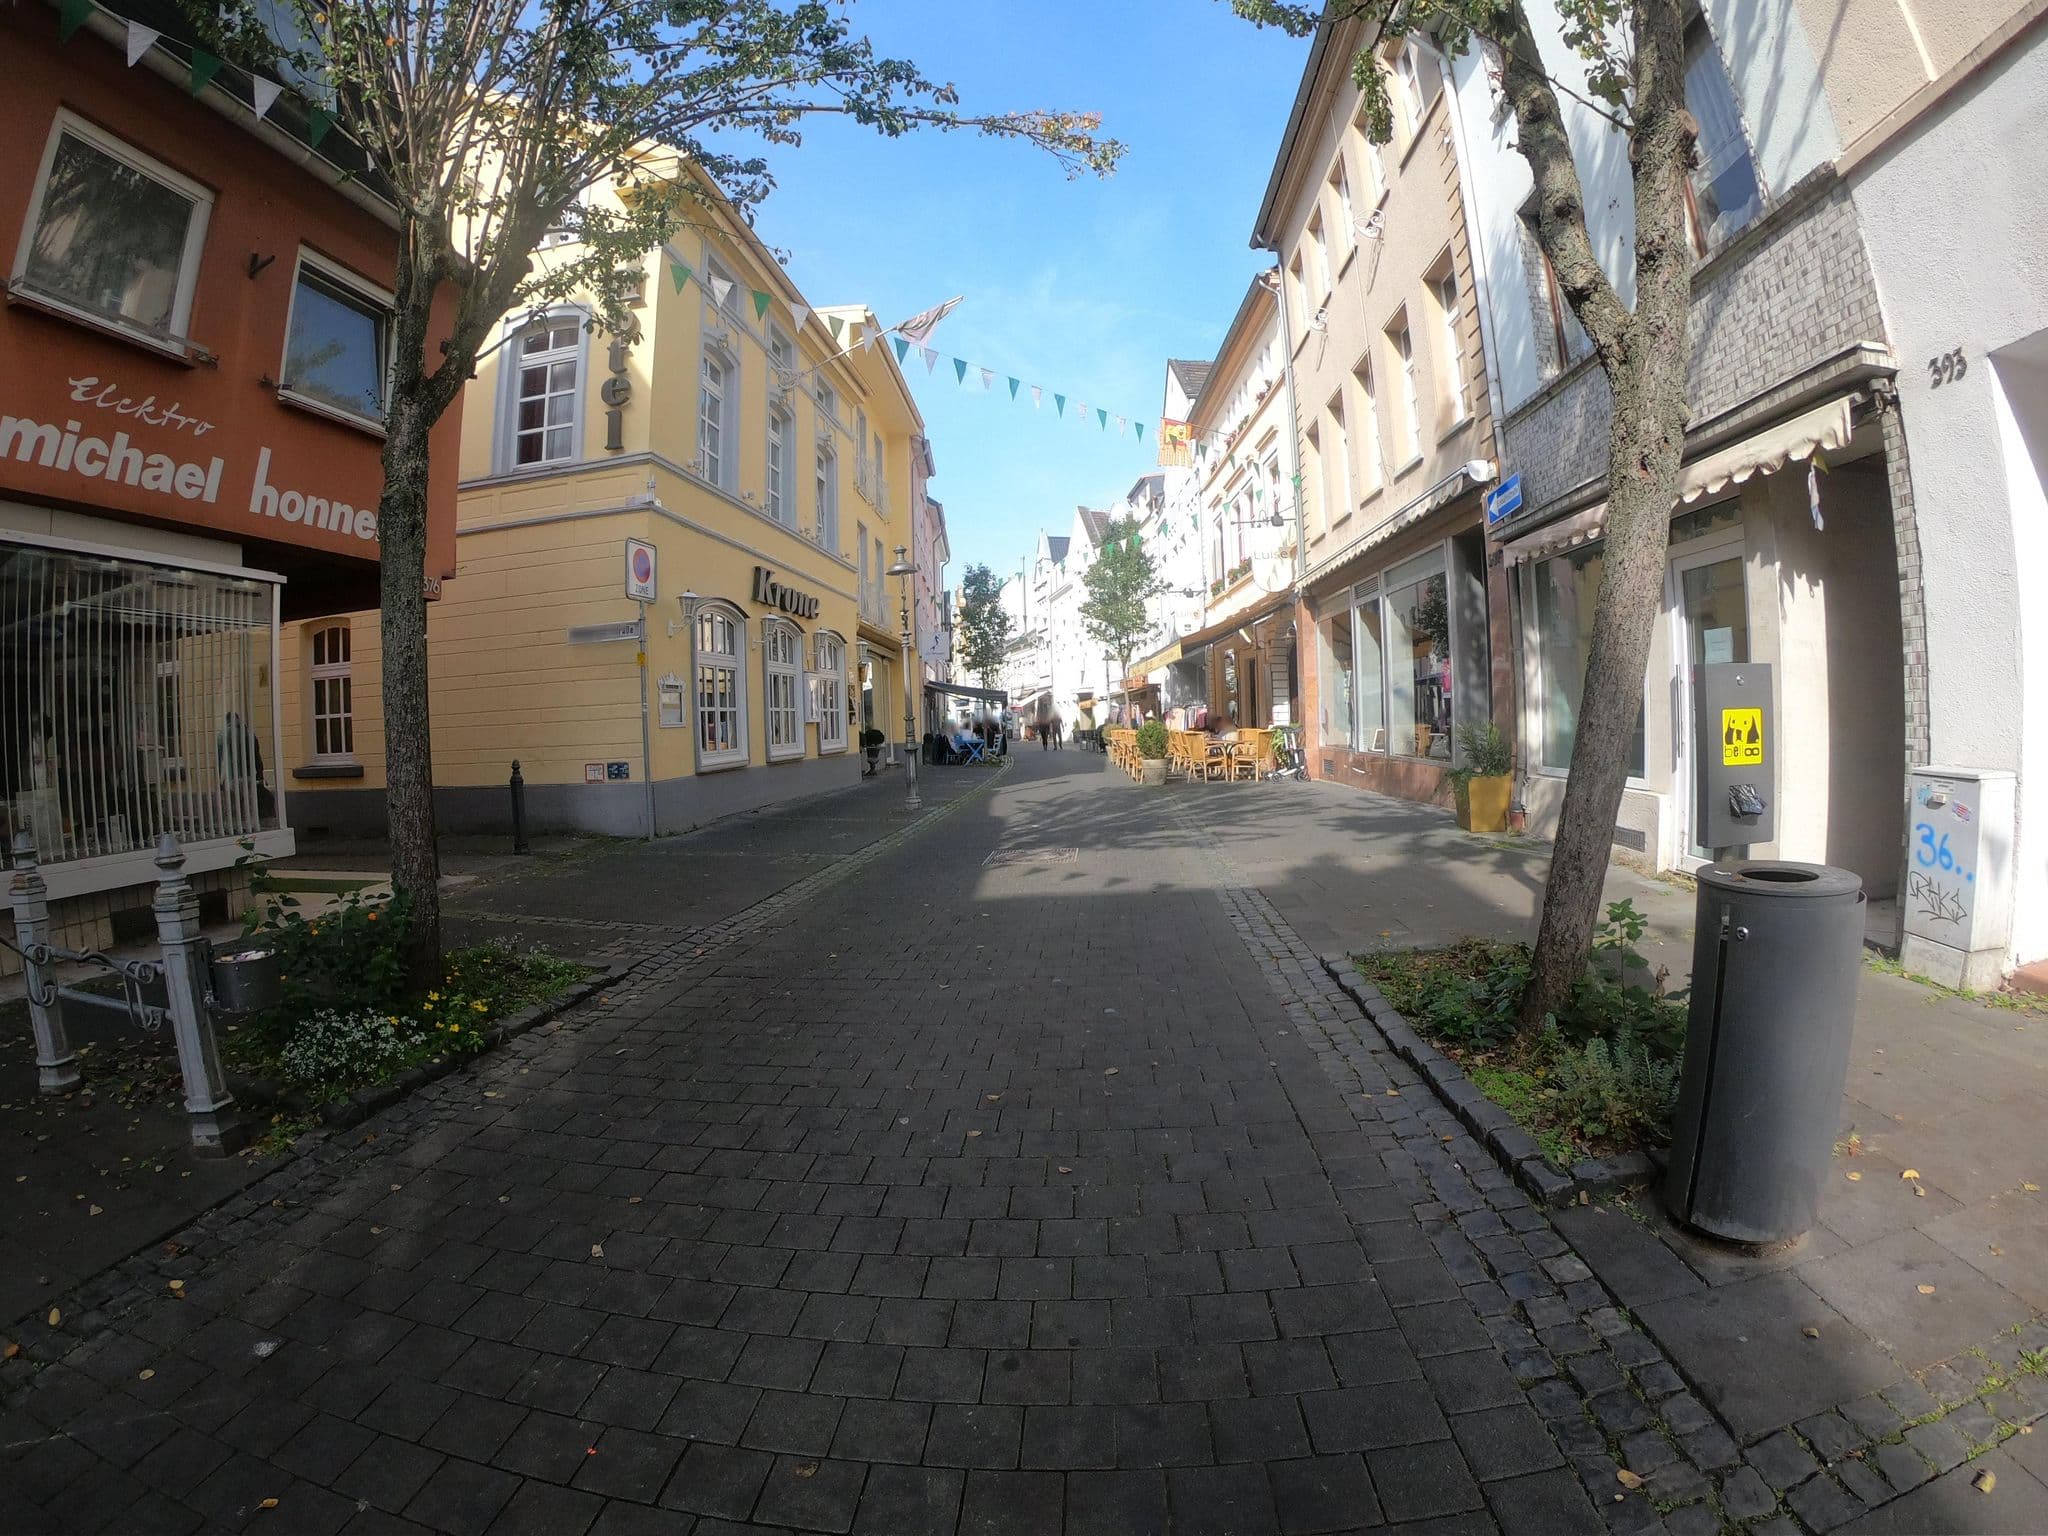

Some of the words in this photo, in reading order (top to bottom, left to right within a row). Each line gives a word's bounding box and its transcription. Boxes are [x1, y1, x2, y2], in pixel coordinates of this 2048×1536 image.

[1928, 347, 1967, 389] 393
[68, 376, 215, 436] Elektro
[0, 415, 224, 503] michael
[250, 446, 381, 542] honne
[751, 566, 820, 619] Krone
